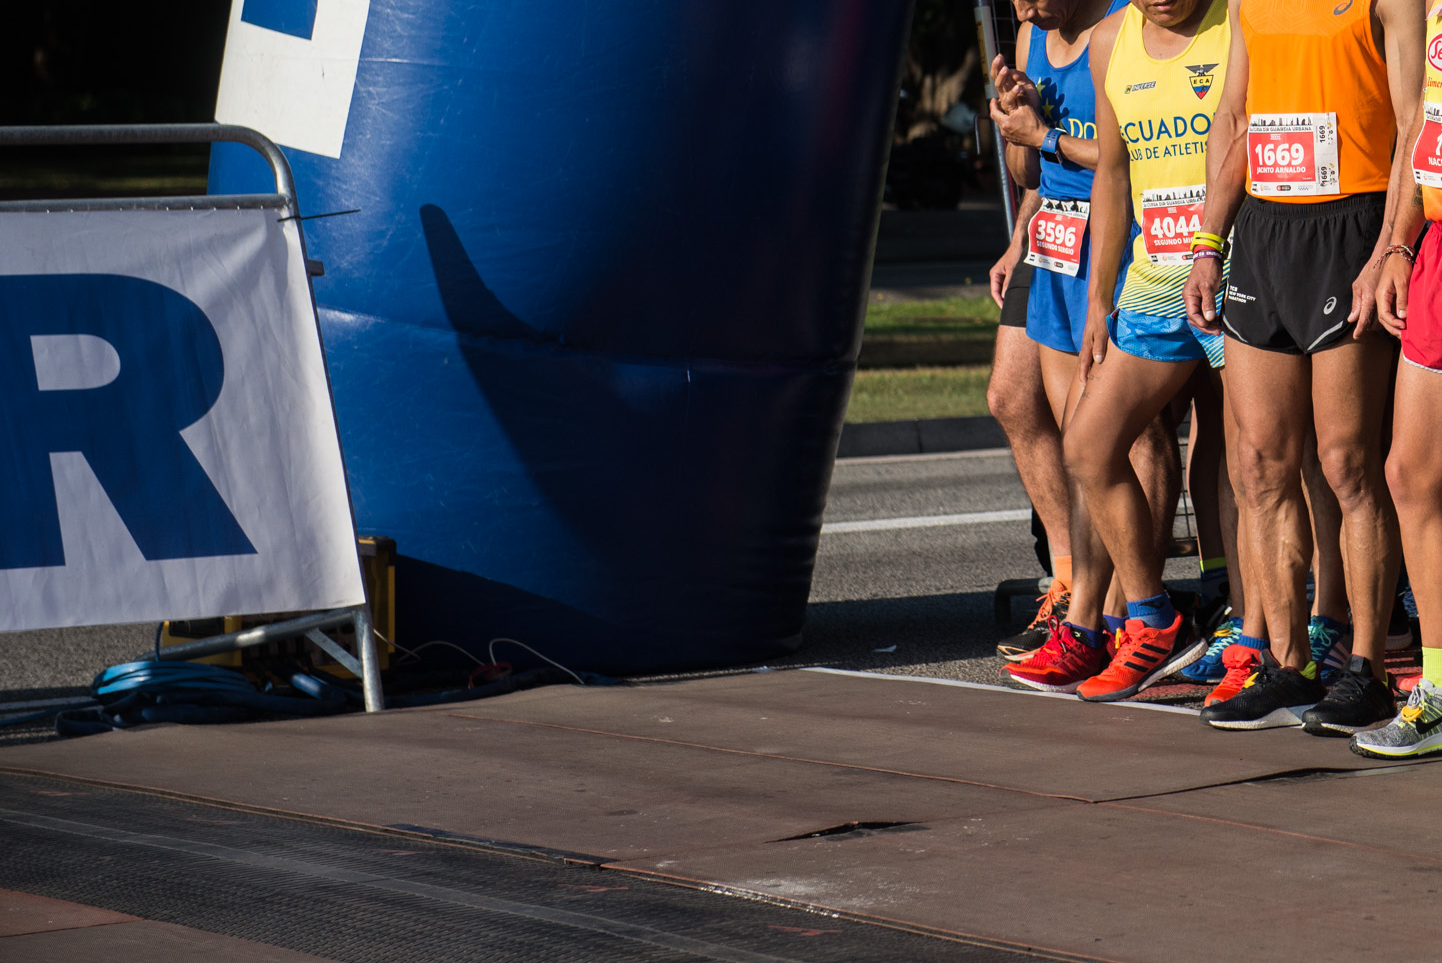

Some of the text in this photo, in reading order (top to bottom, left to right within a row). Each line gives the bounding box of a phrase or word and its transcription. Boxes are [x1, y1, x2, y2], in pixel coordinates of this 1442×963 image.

[1120, 112, 1216, 144] CUADO
[1130, 148, 1143, 161] LUB
[1145, 146, 1160, 159] DE
[1255, 143, 1304, 166] 1669
[1256, 167, 1274, 175] JACINTO
[1036, 219, 1076, 247] 3596
[1150, 215, 1201, 238] 4044
[1036, 241, 1074, 255] SEGUNDO SERGIO
